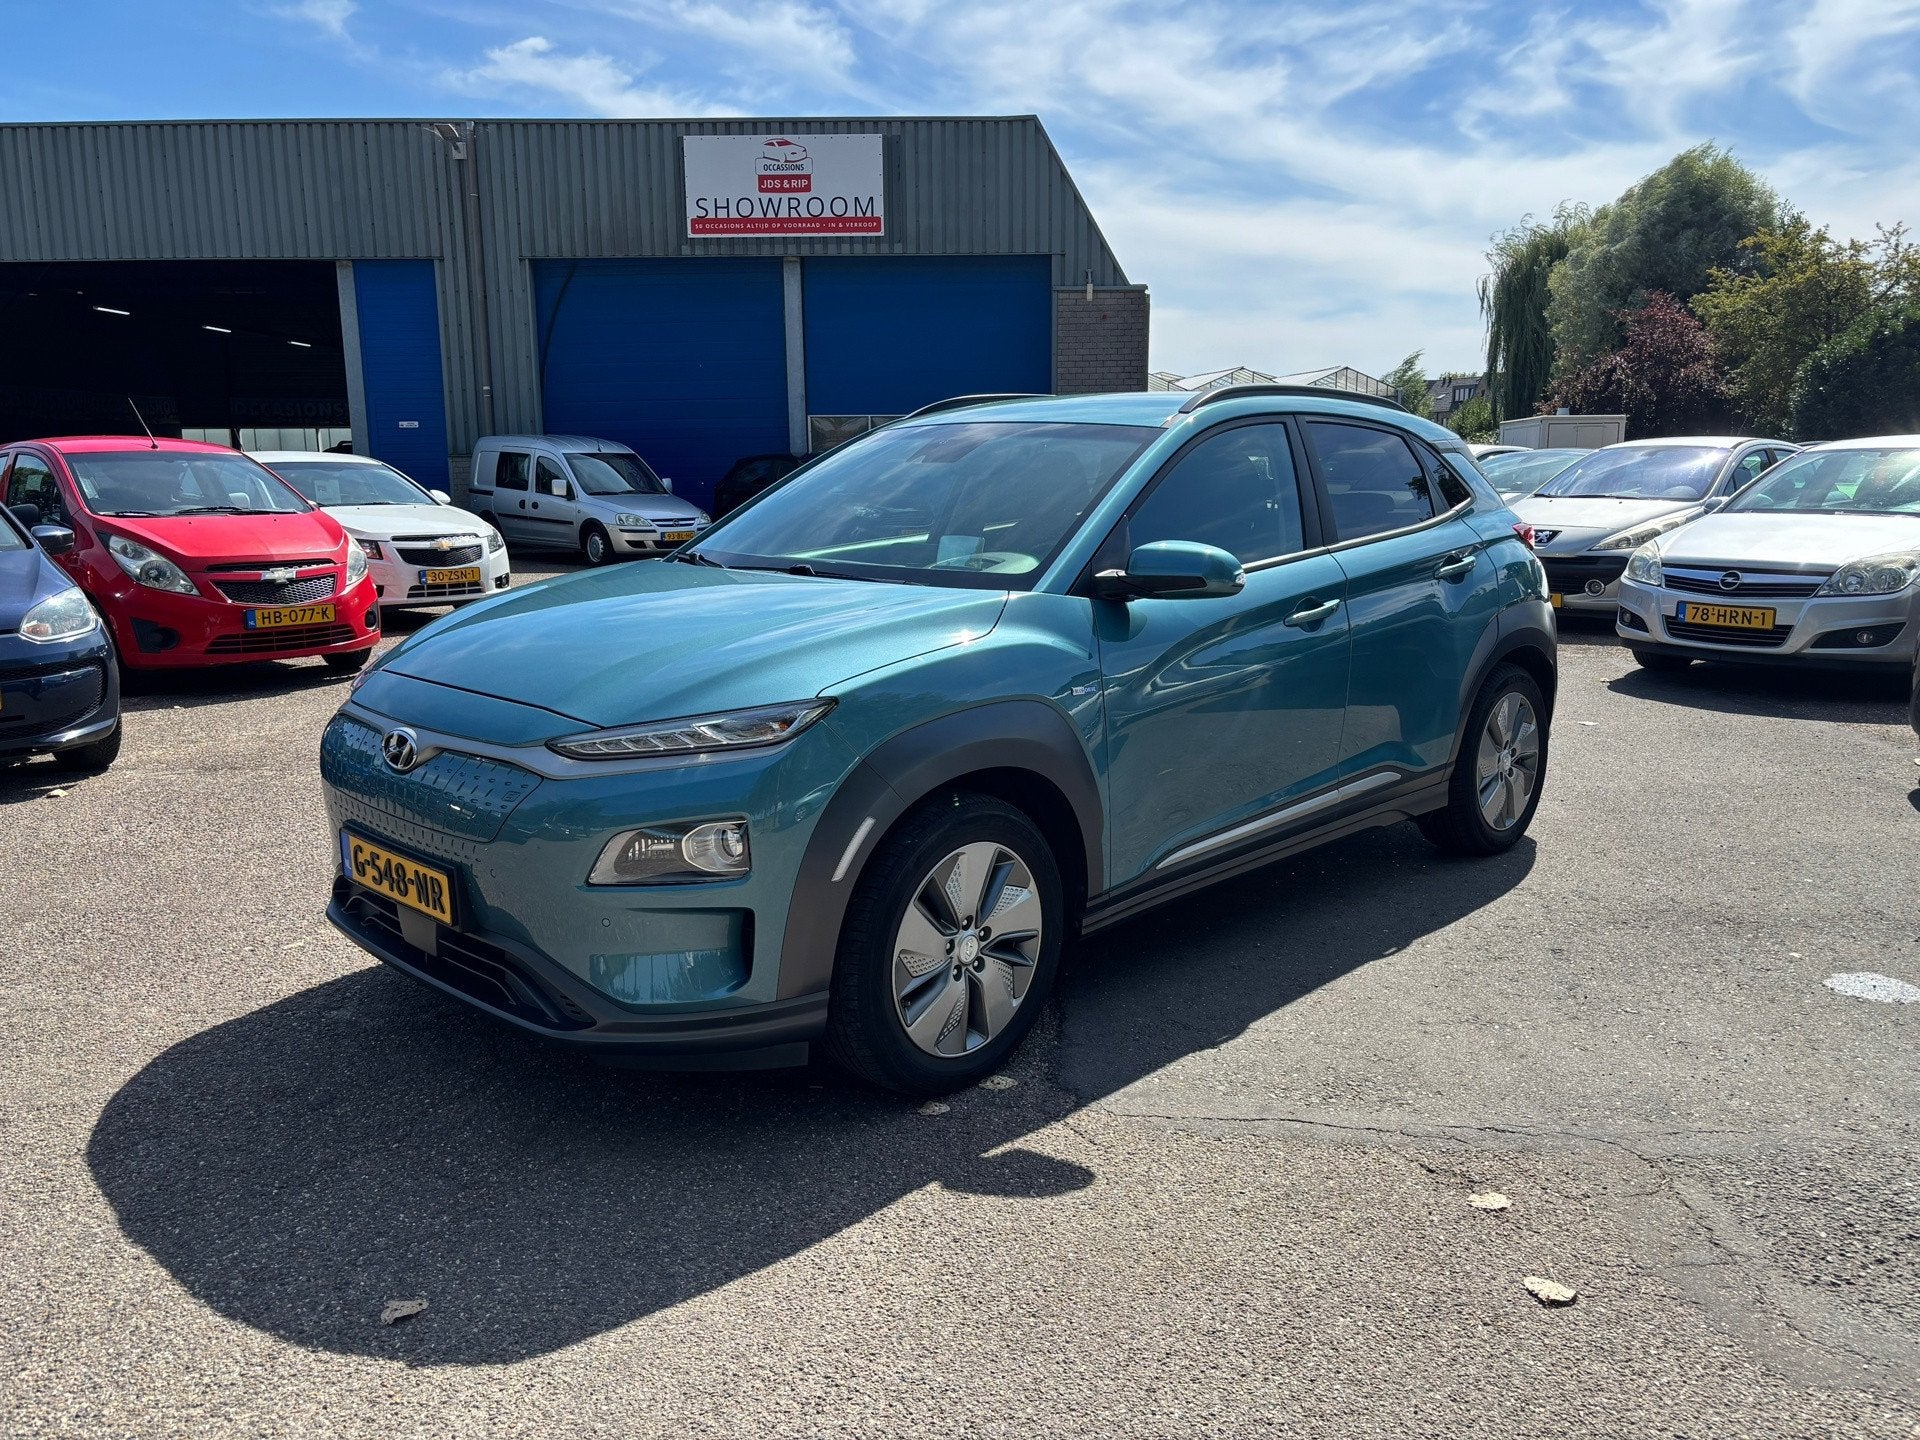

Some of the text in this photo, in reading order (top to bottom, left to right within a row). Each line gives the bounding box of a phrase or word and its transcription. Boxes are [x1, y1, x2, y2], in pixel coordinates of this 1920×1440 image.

[763, 163, 805, 171] OCCASSIONS
[761, 179, 809, 188] JDS & RIP
[695, 196, 874, 218] SHOWROOM
[430, 569, 475, 582] 30-ZSN-1
[261, 606, 330, 625] HB-077-K
[1690, 606, 1766, 626] 78-HRN-1
[353, 844, 446, 914] G-548-NR
